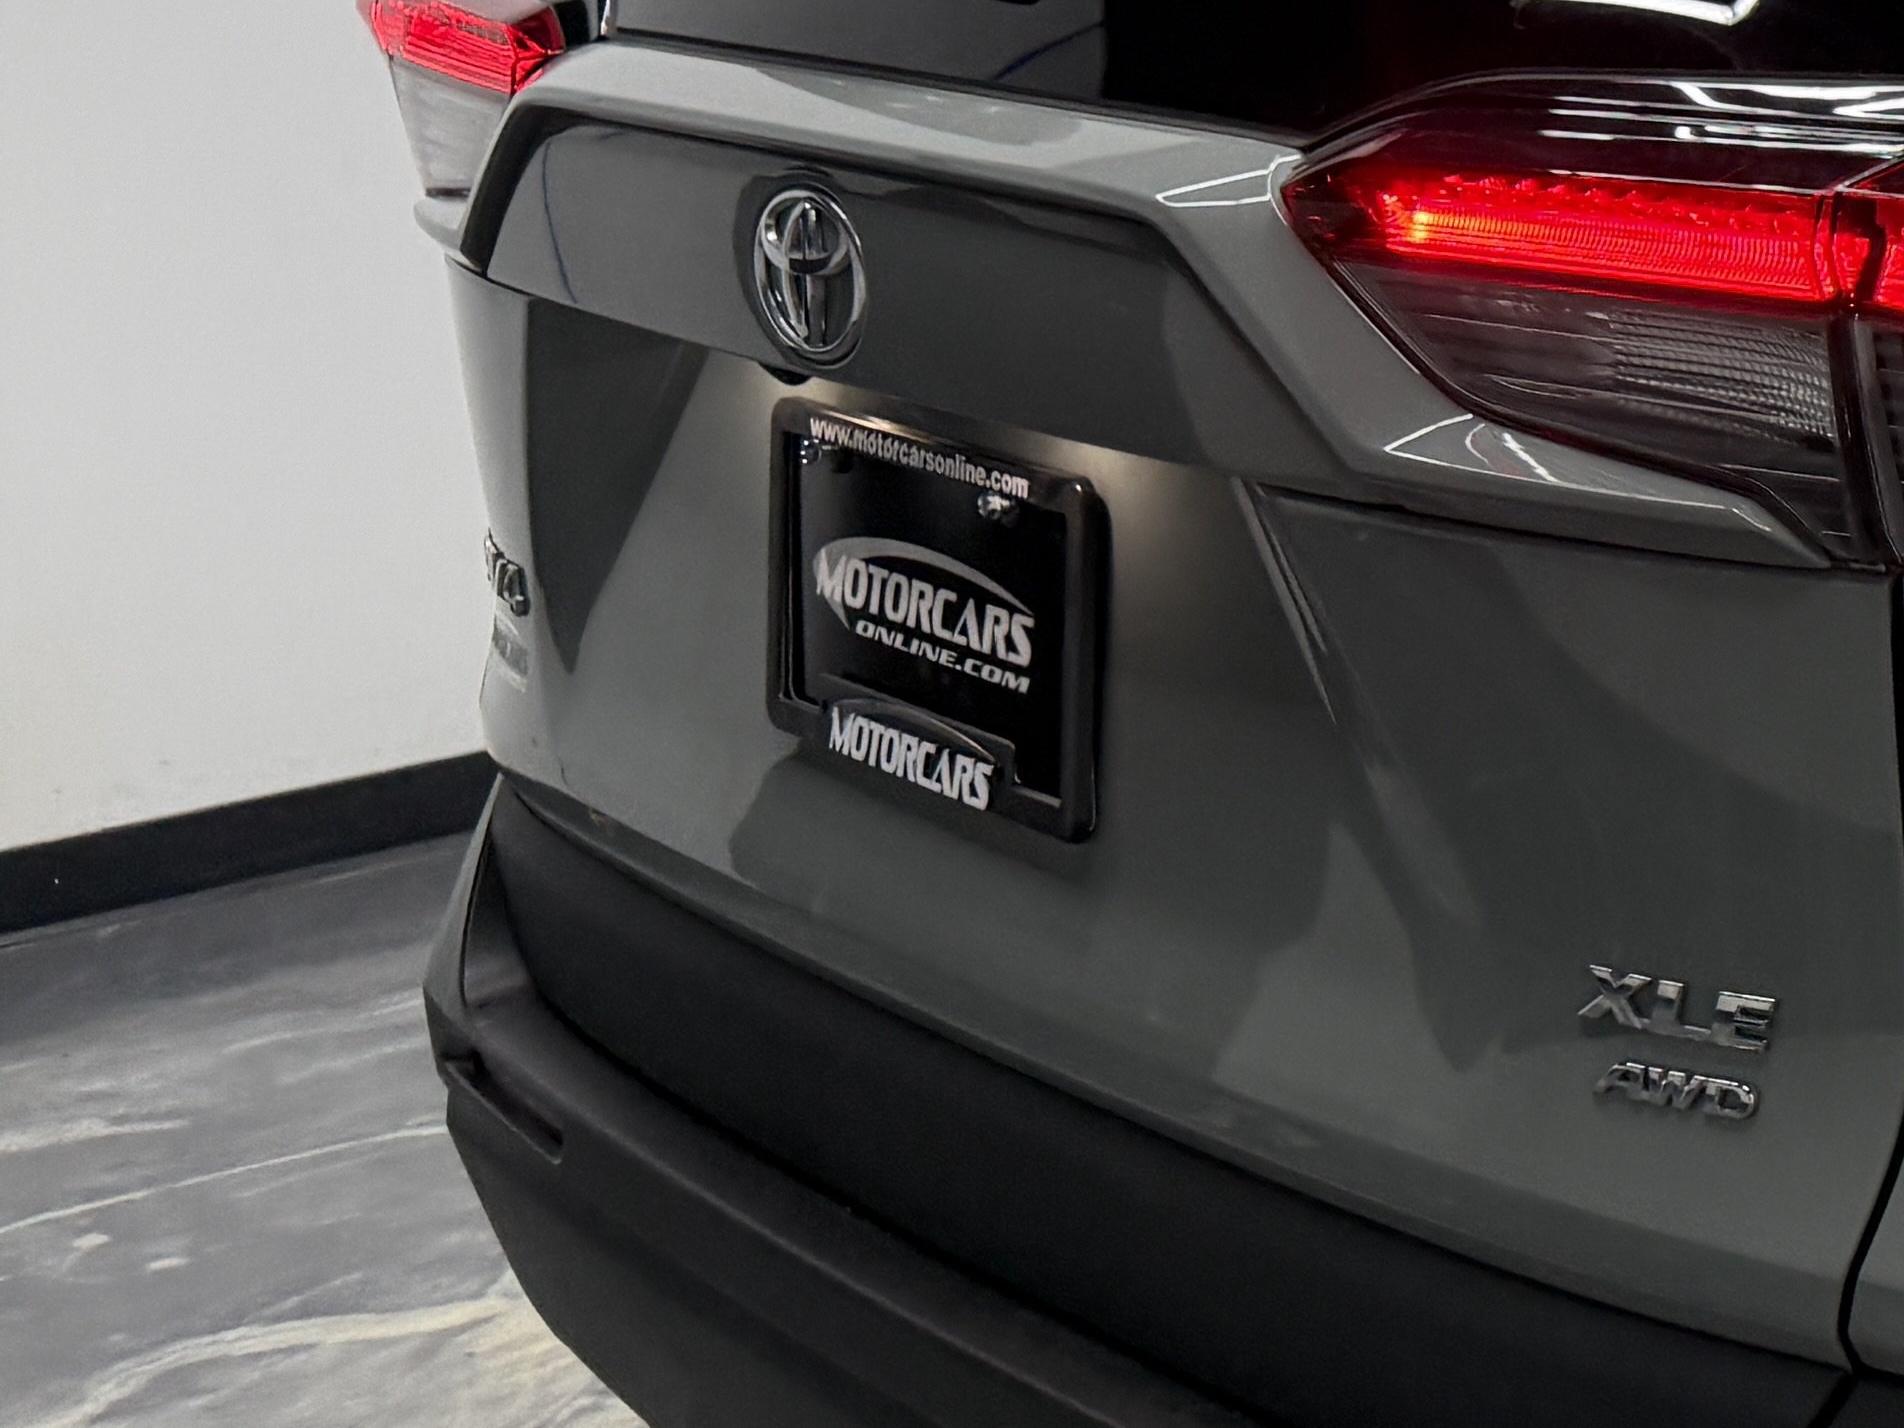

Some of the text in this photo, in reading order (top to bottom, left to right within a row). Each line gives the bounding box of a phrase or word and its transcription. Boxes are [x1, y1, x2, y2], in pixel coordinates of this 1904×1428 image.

[809, 417, 1029, 499] www.motorcarsonline.com
[815, 547, 1035, 669] MOTORCARS
[855, 619, 1031, 694] ONLINE.COM
[828, 705, 995, 812] MOTORCARS
[1577, 963, 1776, 1052] XLE
[1594, 1061, 1755, 1120] AWD
